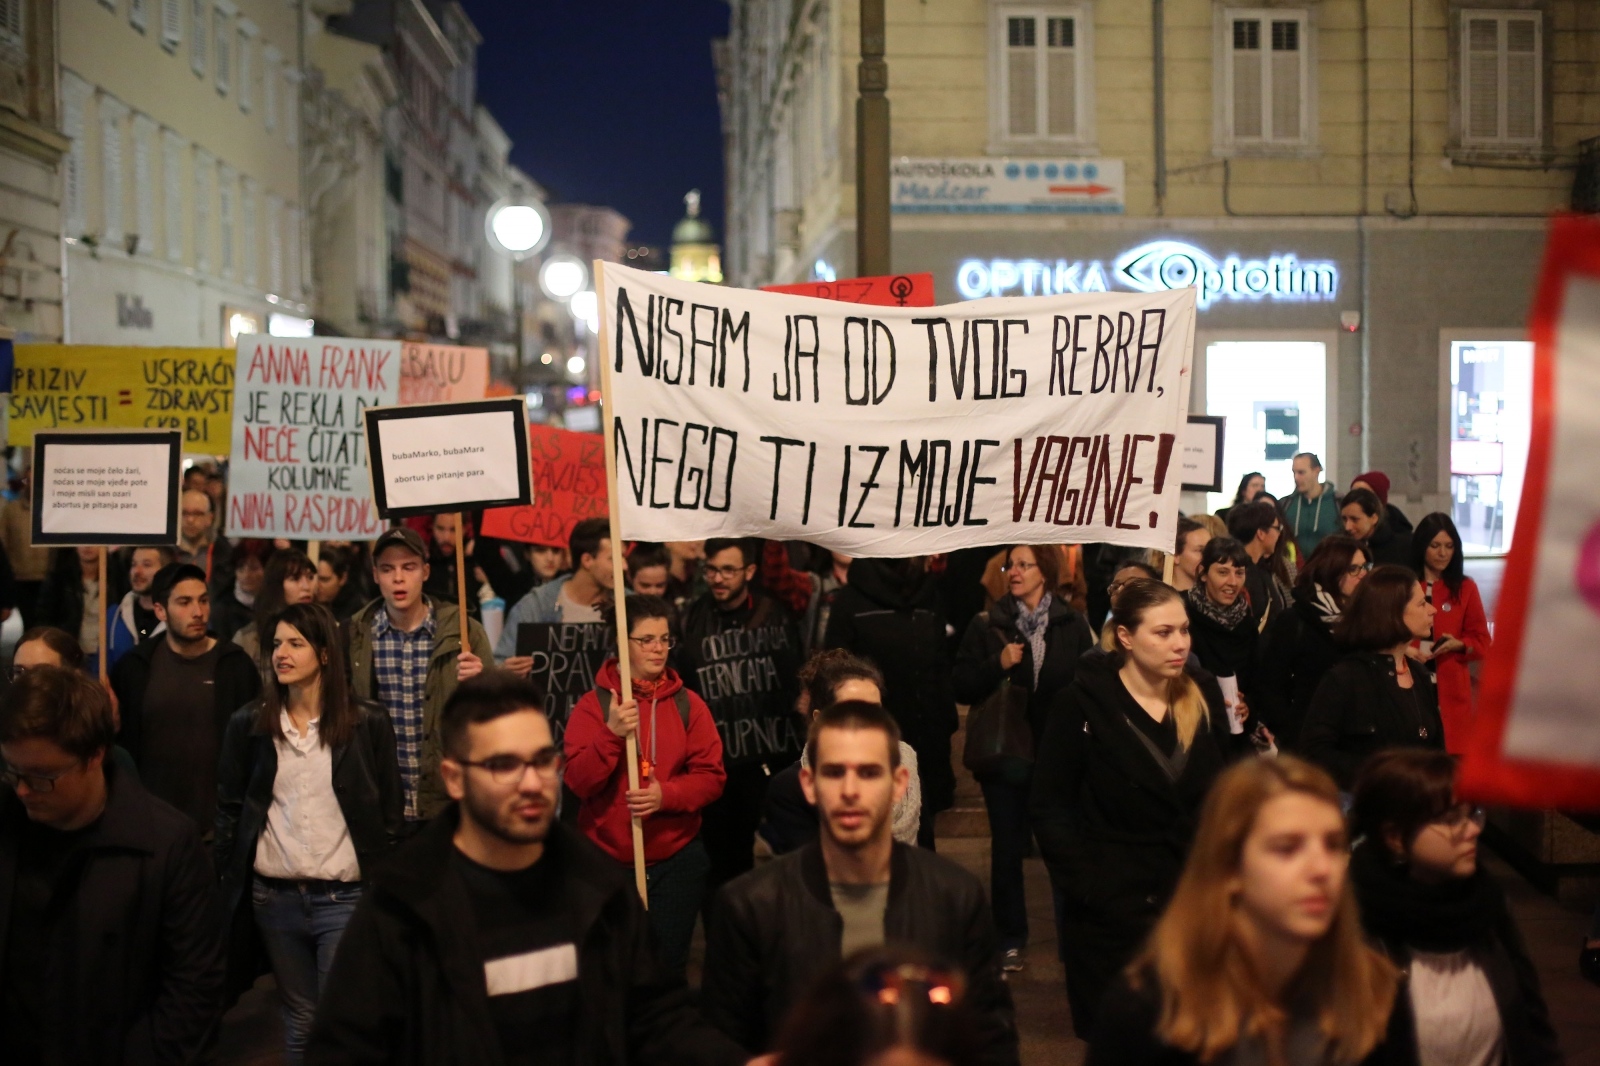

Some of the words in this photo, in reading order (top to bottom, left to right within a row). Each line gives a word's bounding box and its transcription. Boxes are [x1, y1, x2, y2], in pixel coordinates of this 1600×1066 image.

[957, 259, 1107, 298] OPTIKA
[615, 287, 750, 392] NISAM
[773, 315, 819, 403] JA
[844, 316, 896, 405] OD
[912, 317, 1029, 402] TVOG
[1049, 309, 1166, 398] REBRA,
[13, 368, 87, 391] PRIZIV
[247, 343, 311, 387] ANNA
[318, 344, 391, 392] FRANK
[9, 395, 108, 428] SAVJESTI
[243, 391, 270, 424] JE
[280, 391, 344, 427] REKLA
[308, 427, 367, 468] ČITAT
[392, 449, 441, 460] bubaMarko,
[443, 446, 485, 456] bubaMara
[86, 467, 106, 476] moje
[86, 479, 106, 487] moje
[267, 466, 353, 491] KOLUMNE
[394, 475, 425, 484] abortus
[427, 473, 434, 482] je
[436, 470, 464, 481] pitanje
[466, 469, 485, 478] para
[614, 416, 737, 512] NEGO
[760, 436, 816, 526] TI
[838, 445, 889, 528] IZ
[894, 439, 1000, 528] MOJE
[1012, 433, 1175, 530] VAGINE!
[52, 501, 81, 509] abortus
[82, 502, 90, 510] je
[120, 502, 138, 510] para
[56, 490, 76, 498] moje
[230, 492, 275, 531] NINA
